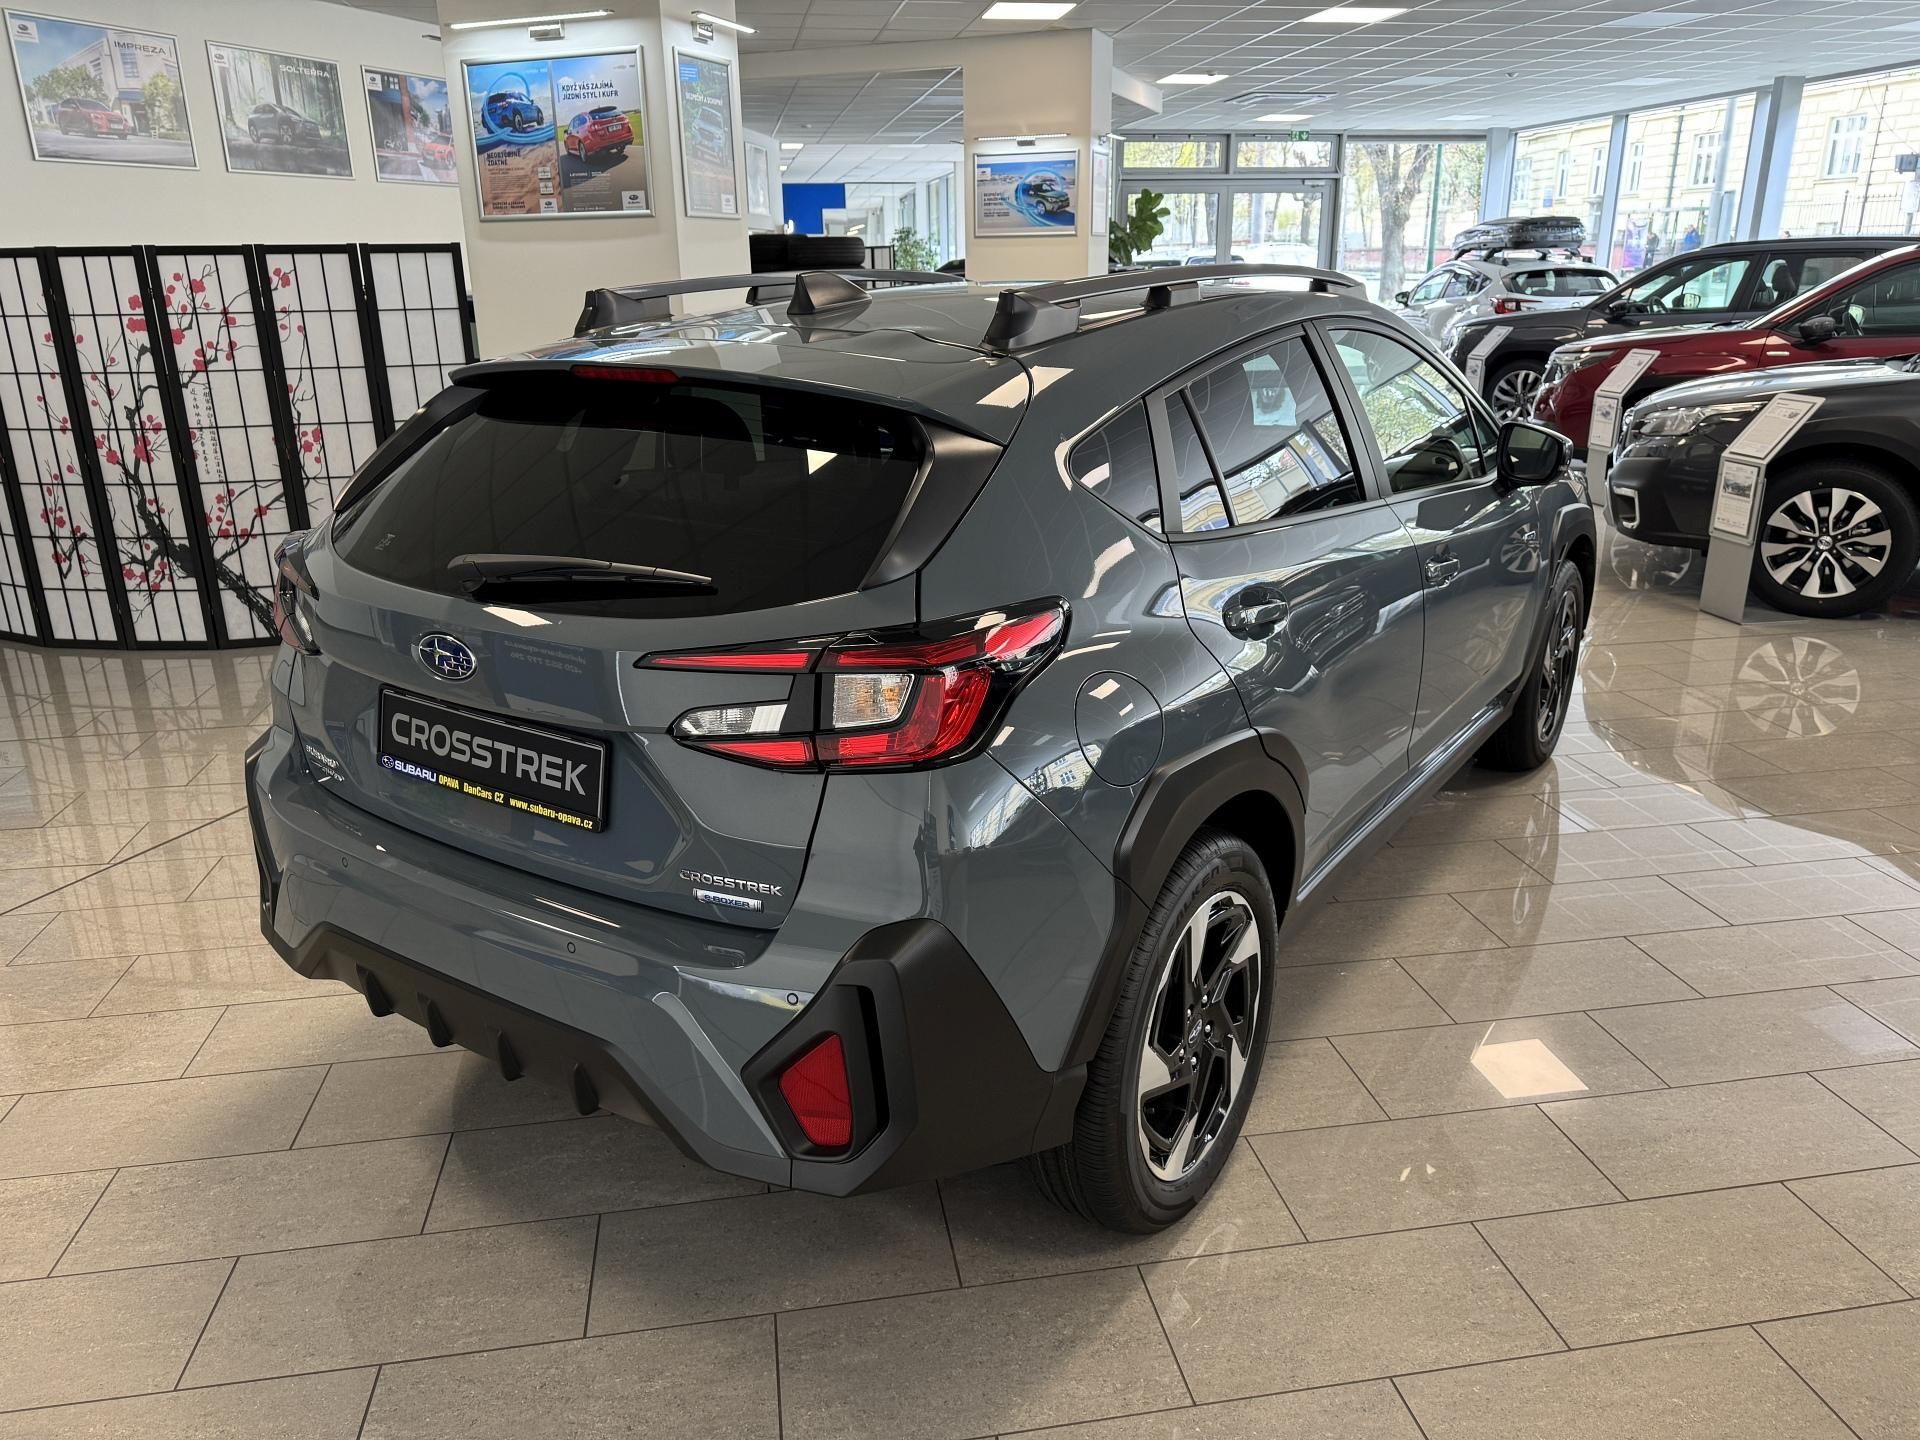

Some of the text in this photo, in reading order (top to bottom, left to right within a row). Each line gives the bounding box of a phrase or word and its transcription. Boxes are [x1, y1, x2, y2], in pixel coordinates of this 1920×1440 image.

[113, 40, 167, 55] IMPREZA
[279, 64, 331, 79] SOLTERRA
[561, 81, 578, 92] KDYŽ
[578, 80, 590, 91] VÁS
[582, 90, 598, 99] STYL
[601, 88, 619, 98] KUFR
[391, 712, 588, 796] CROSSTREK
[394, 760, 593, 830] SUBARU OPAVA DanCars CZ www.subaru-opava.cz
[679, 869, 784, 897] CROSSTREK
[704, 894, 751, 908] e-BOXER
